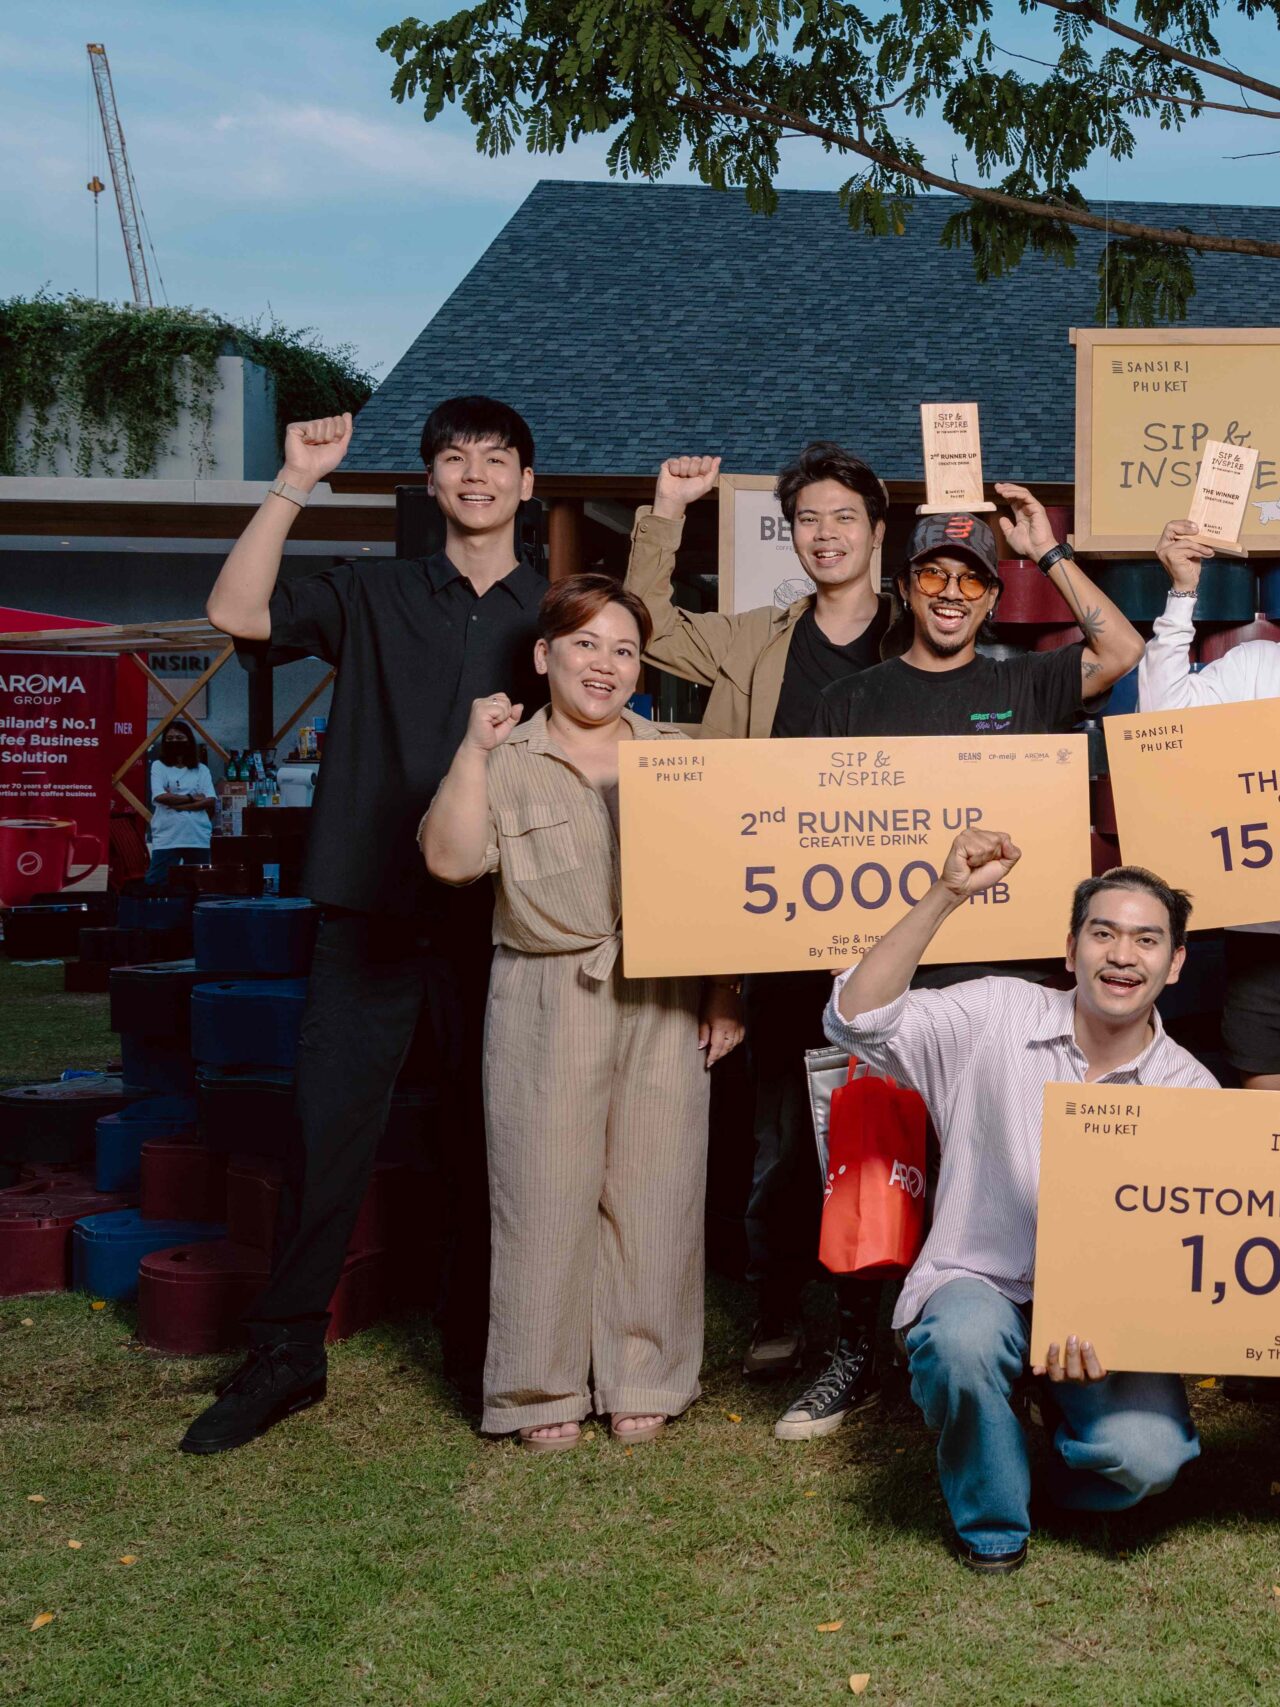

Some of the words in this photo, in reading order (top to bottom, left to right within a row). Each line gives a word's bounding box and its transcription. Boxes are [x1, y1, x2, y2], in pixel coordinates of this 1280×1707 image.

[1128, 361, 1188, 373] SANSIRI
[1134, 381, 1187, 392] PHUKET
[934, 420, 968, 428] INSPIRE
[1144, 422, 1208, 451] SIP
[1223, 420, 1251, 448] &
[1218, 451, 1232, 460] SIP
[1212, 458, 1244, 470] INSPIRE
[1120, 457, 1278, 489] INSE
[1203, 487, 1213, 495] THE
[1215, 490, 1240, 500] WINNER
[14, 696, 62, 705] GROUP
[62, 718, 96, 729] No.1
[1136, 725, 1183, 738] SANSIRI
[30, 734, 99, 747] Business
[1141, 740, 1182, 752] PHUKET
[1, 751, 68, 763] Solution
[652, 757, 704, 766] SANSIRI
[832, 752, 867, 767] SIP
[874, 751, 890, 768] &
[958, 751, 982, 761] BEANS
[1024, 752, 1050, 760] AROMA
[657, 772, 702, 781] PHUKET
[819, 770, 905, 787] INSPIRE
[741, 807, 785, 835] 2nd
[799, 809, 930, 834] RUNNER
[943, 807, 983, 831] UP
[800, 836, 875, 848] CREATIVE
[881, 834, 928, 845] DRINK
[742, 860, 939, 922] 5,000
[832, 935, 850, 946] Sip
[853, 934, 861, 944] &
[809, 947, 823, 957] By
[827, 946, 847, 956] The
[1081, 1104, 1140, 1117] SANSIRI
[1085, 1123, 1137, 1135] PHUKET
[888, 1158, 926, 1199] ARO
[1246, 1349, 1262, 1360] By
